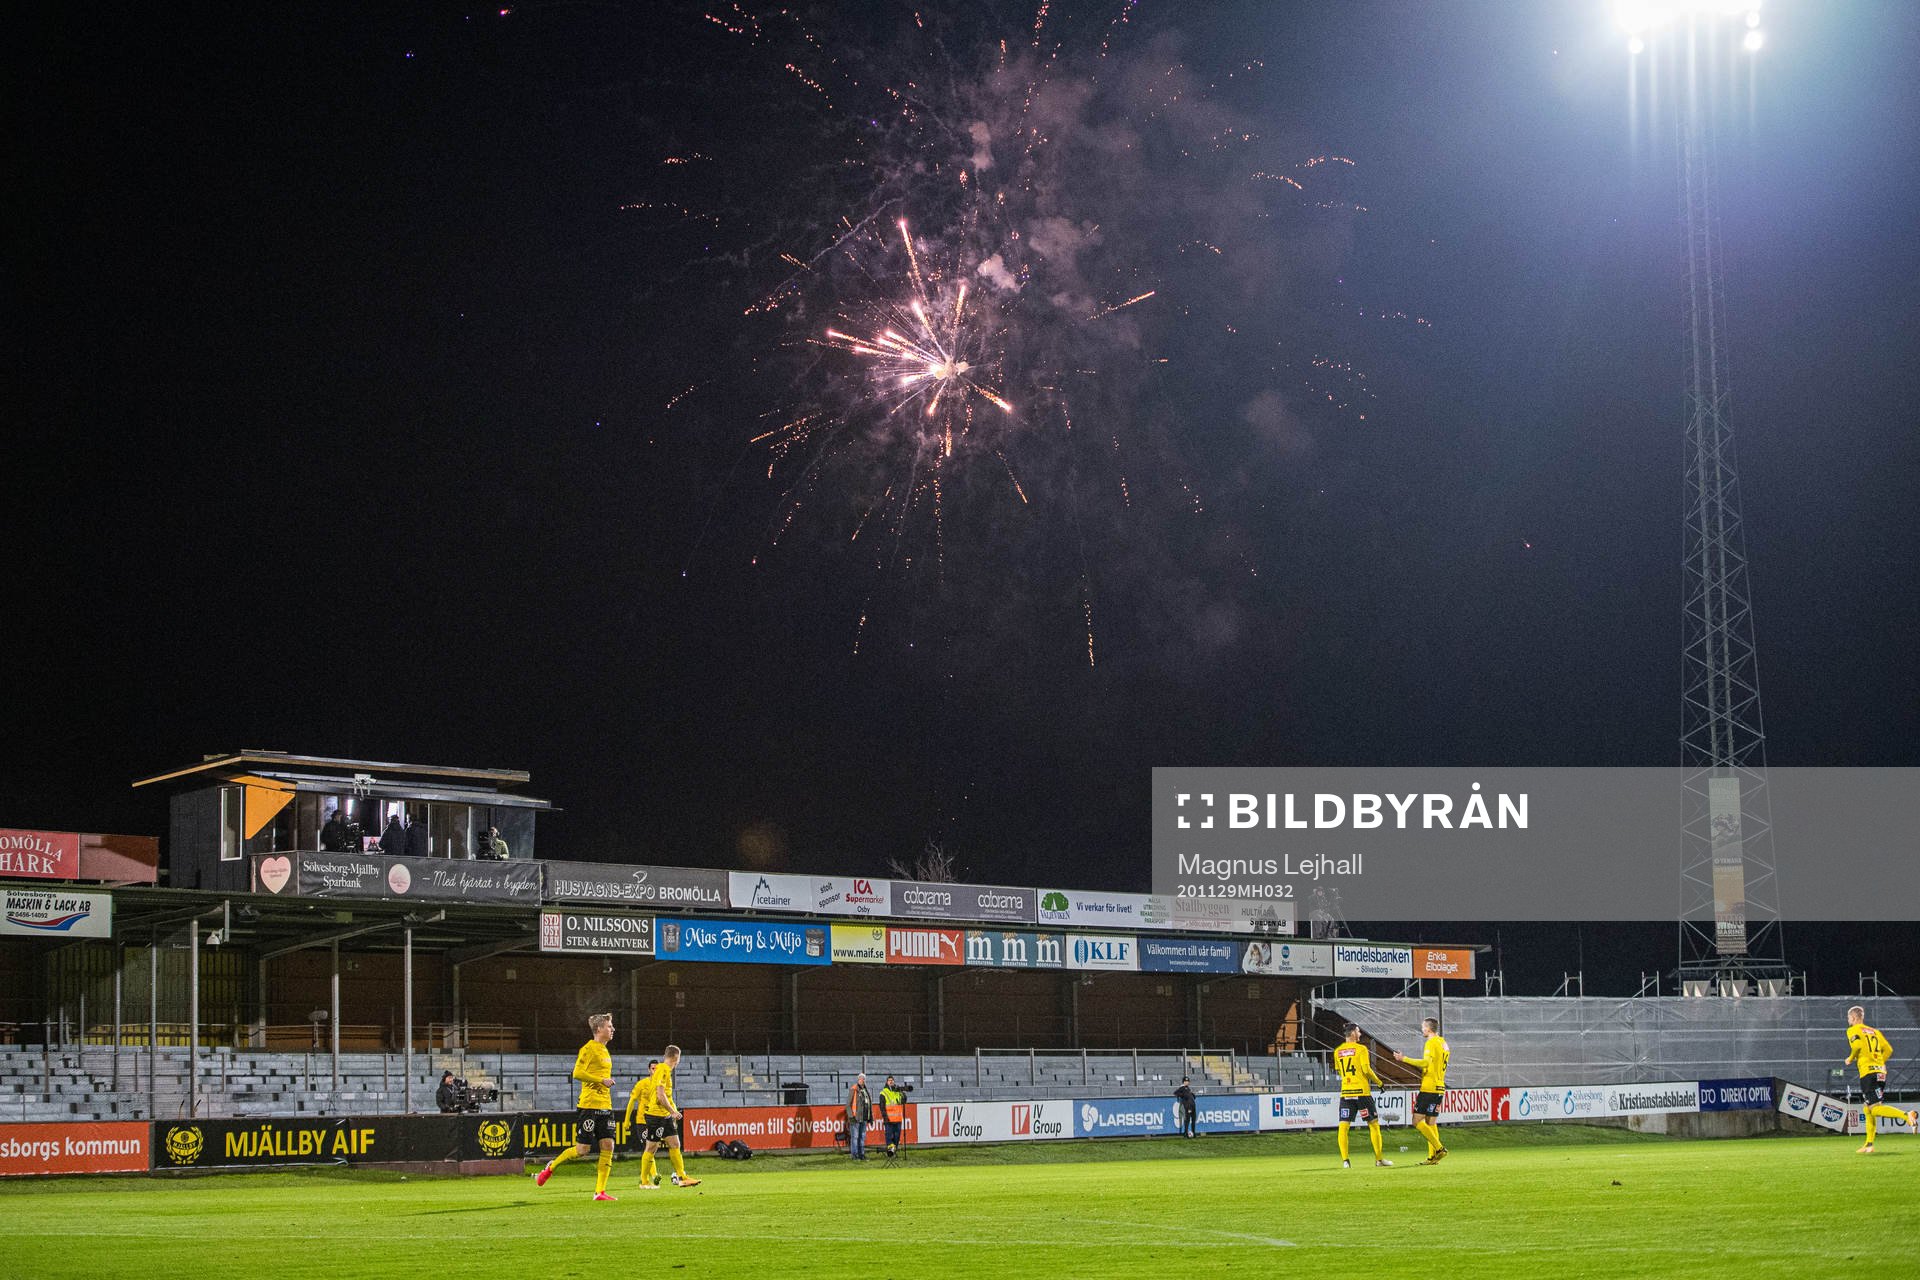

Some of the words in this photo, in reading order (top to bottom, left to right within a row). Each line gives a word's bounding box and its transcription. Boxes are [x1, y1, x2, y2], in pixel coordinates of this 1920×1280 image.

[303, 860, 380, 878] Sölvesborg-Mjällby
[322, 876, 361, 891] Sparbank
[432, 870, 456, 887] Med
[503, 874, 537, 896] bygden
[819, 882, 833, 894] stolt
[853, 879, 873, 895] ICA
[6, 890, 57, 898] Sölvesborgs
[555, 880, 656, 899] HUSVAGNS-EXPO
[659, 886, 721, 902] BROMÖLLA
[903, 886, 951, 906] colorama
[6, 898, 42, 909] MASKIN
[45, 899, 51, 910] &
[54, 900, 76, 912] LACK
[78, 901, 91, 912] AB
[757, 894, 791, 906] icetainer
[818, 892, 841, 908] sponsor
[845, 894, 884, 904] Supermarket
[977, 890, 1023, 909] colorama
[856, 905, 870, 914] Osby
[1076, 902, 1083, 911] Vi
[1085, 902, 1104, 912] verkar
[1106, 903, 1115, 913] för
[1117, 904, 1132, 913] livet!
[1175, 898, 1230, 917] Stallbyggen
[543, 914, 559, 925] SYD
[566, 917, 580, 931] O.
[583, 917, 649, 933] NILSSONS
[1278, 919, 1287, 927] AB
[566, 936, 590, 947] STEN
[591, 938, 599, 947] &
[600, 938, 649, 949] HANTVERK
[685, 928, 717, 948] Mias
[720, 929, 753, 953] Färg
[756, 930, 767, 949] &
[769, 930, 801, 954] Miljö
[890, 930, 939, 959] PUMA
[833, 947, 884, 959] www.maif.se
[1091, 941, 1129, 960] KLF
[1147, 944, 1186, 956] Välkommen
[1188, 946, 1197, 956] till
[1199, 947, 1208, 957] vår
[1210, 946, 1231, 959] familj!
[1338, 947, 1409, 963] Handelsbanken
[1428, 952, 1446, 960] Enkla
[1361, 966, 1388, 975] Sölvesborg
[1425, 962, 1458, 974] Elbolaget
[1865, 1035, 1879, 1053] 12
[1340, 1058, 1356, 1076] 14
[1529, 1091, 1560, 1104] sölvesborg
[1573, 1089, 1602, 1102] sölvesborg
[1619, 1091, 1696, 1111] Kristianstadsbladet
[1721, 1087, 1747, 1103] DIREKT
[1749, 1086, 1771, 1102] OPTIK
[953, 1106, 963, 1121] IV
[1034, 1104, 1043, 1119] IV
[1195, 1109, 1250, 1124] ARSSON
[690, 1118, 764, 1137] Välkommen
[767, 1117, 783, 1134] till
[787, 1116, 844, 1133] Sölvesbor
[1099, 1113, 1163, 1126] LARSSON
[953, 1122, 982, 1139] Group
[1034, 1119, 1061, 1137] Group
[65, 1137, 140, 1156] kommun
[225, 1125, 326, 1157] MJÄLLBY
[332, 1129, 375, 1155] AIF
